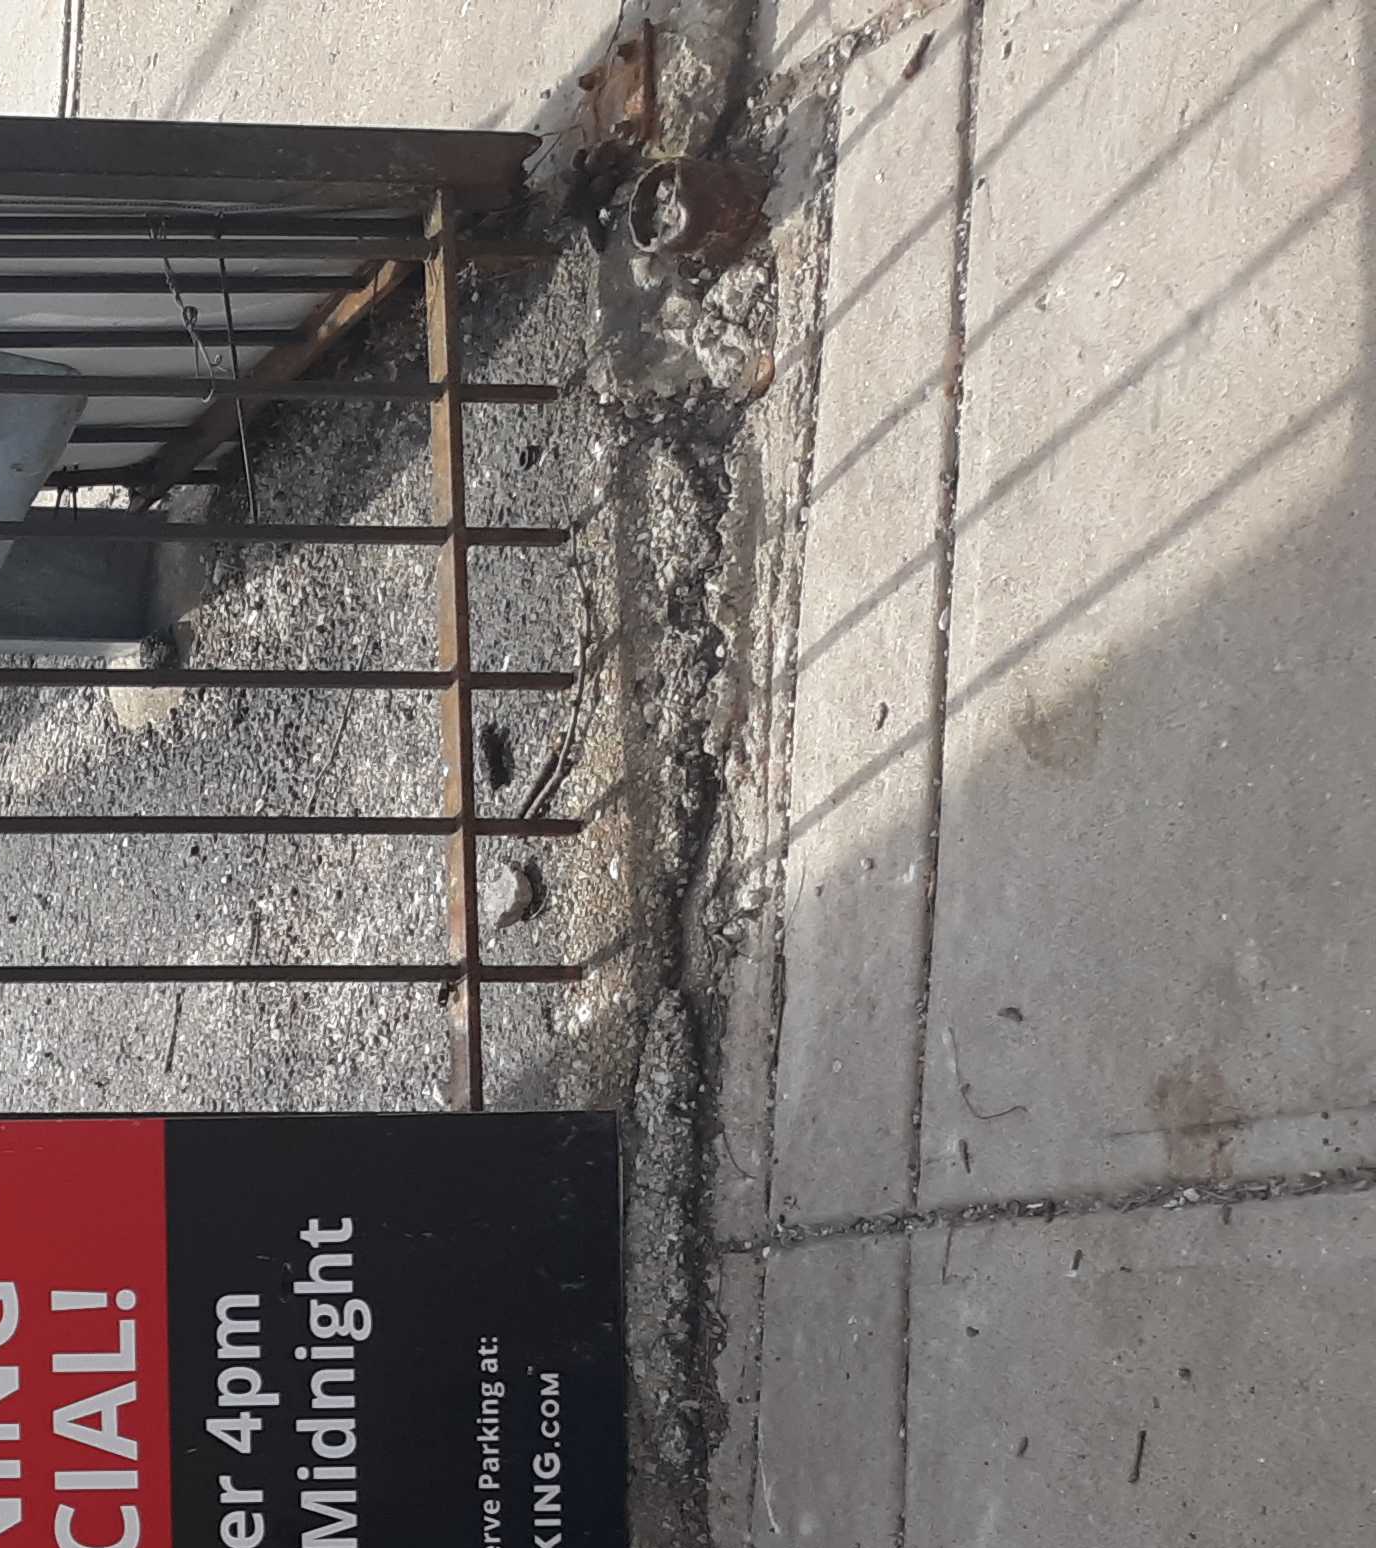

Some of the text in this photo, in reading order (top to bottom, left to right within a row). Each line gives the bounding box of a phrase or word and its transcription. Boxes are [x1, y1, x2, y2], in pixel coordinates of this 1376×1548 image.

[205, 1294, 280, 1454] 4pm
[478, 1336, 499, 1373] at:
[477, 1382, 505, 1490] Parking
